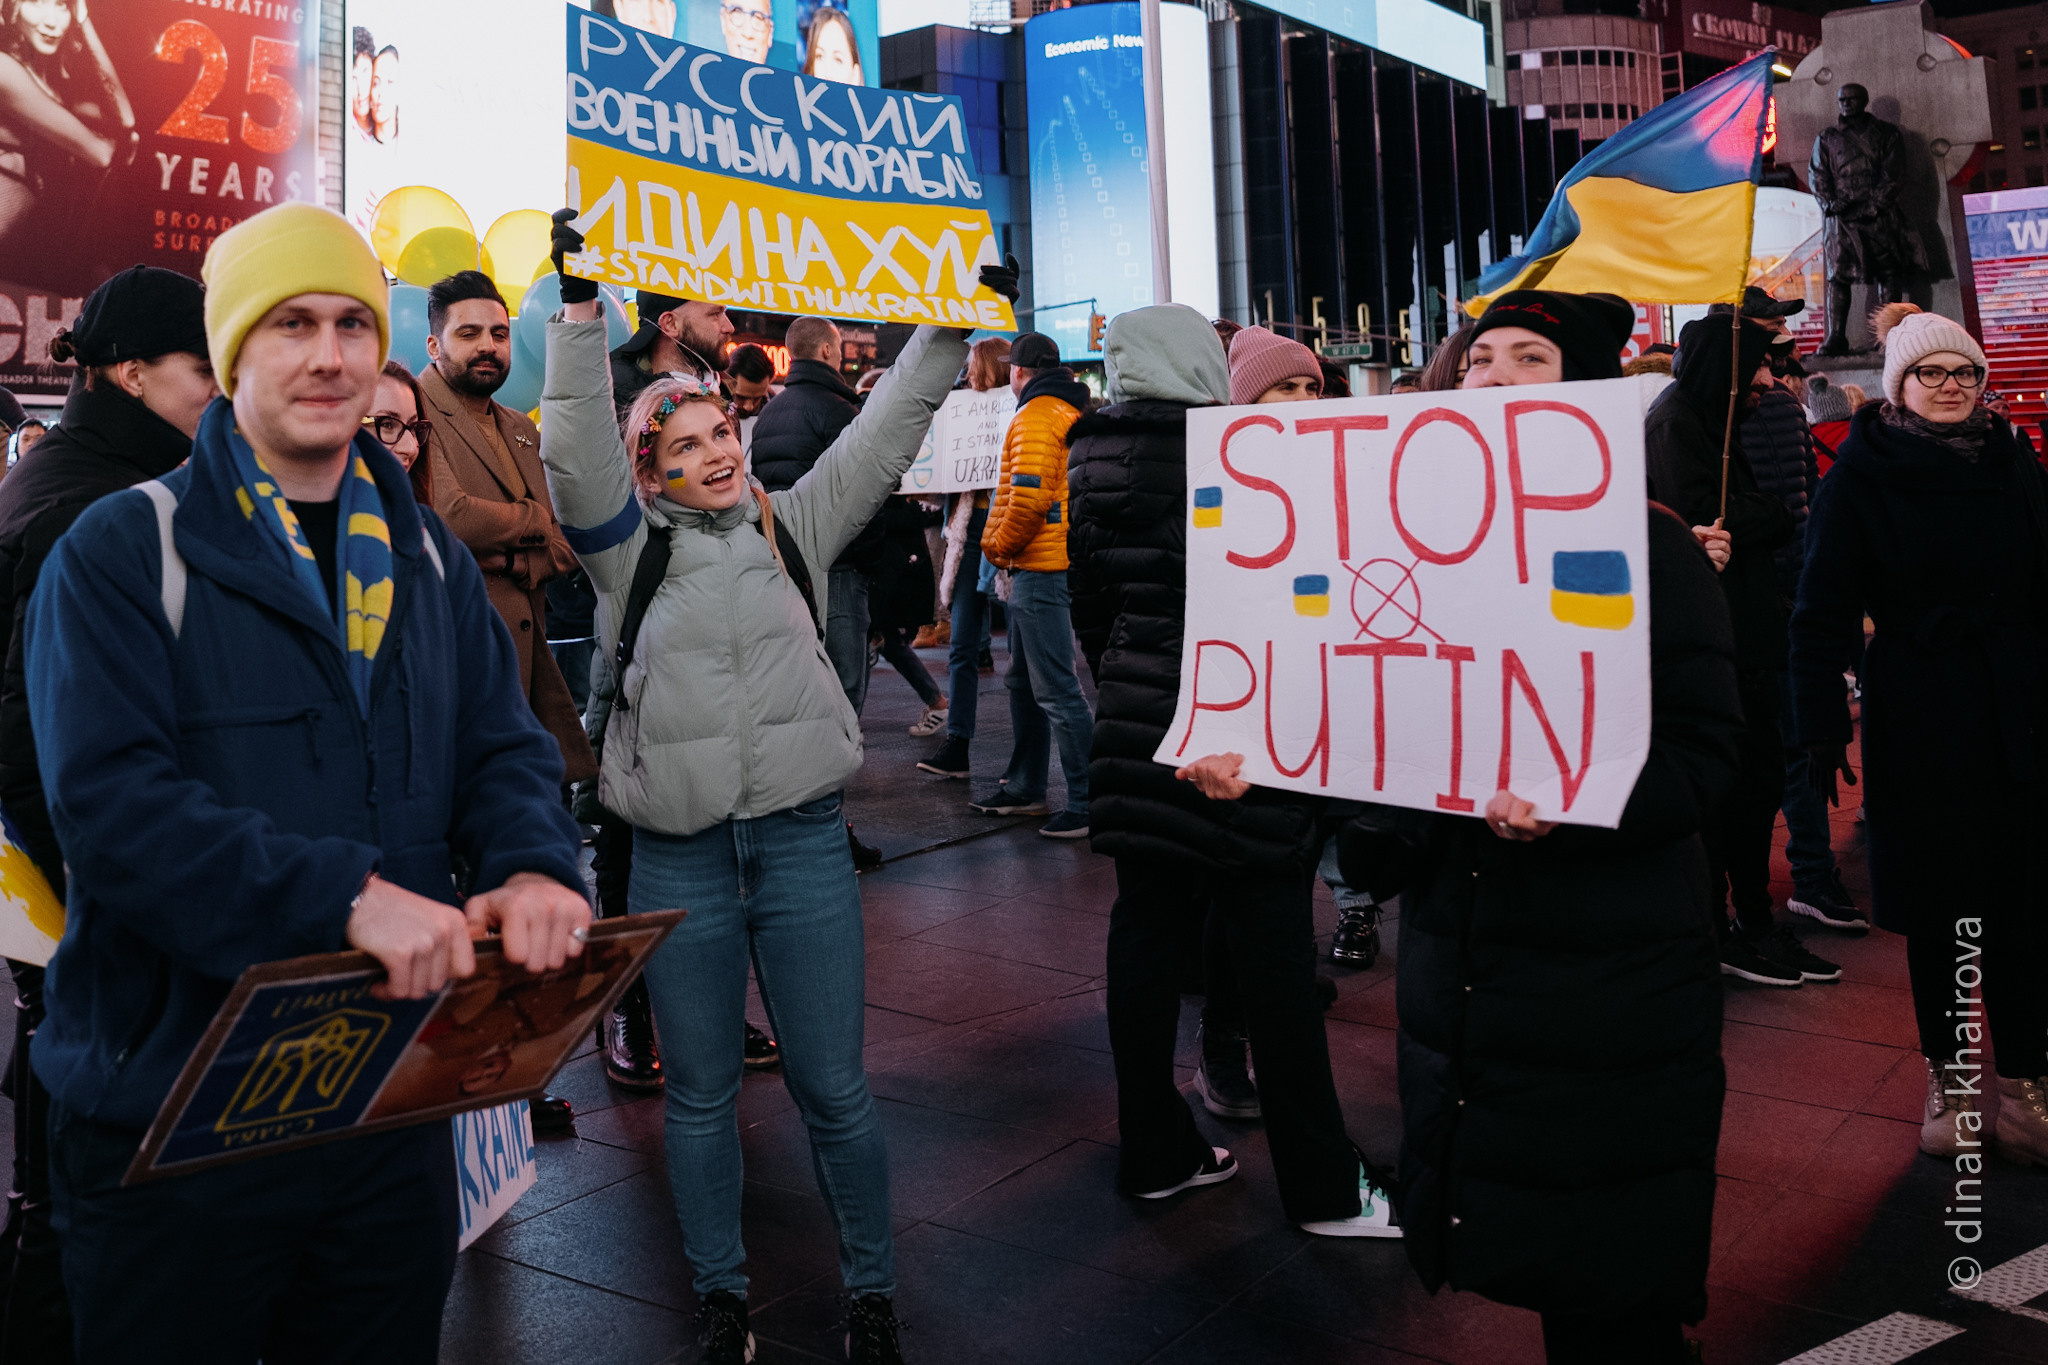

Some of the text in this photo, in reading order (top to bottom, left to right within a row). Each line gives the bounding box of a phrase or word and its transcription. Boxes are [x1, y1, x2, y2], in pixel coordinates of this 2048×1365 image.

[1044, 35, 1109, 58] Economic
[1692, 12, 1767, 46] CROWNE
[155, 18, 304, 154] 25
[580, 15, 966, 154] РУССКИЙ
[567, 72, 983, 200] ВОЕННЫЙ КОРАБЛЬ
[155, 152, 303, 204] YEARS
[155, 210, 246, 232] BROAD
[846, 220, 1008, 303] ХУЙ
[565, 244, 1006, 327] #STANDWITHUKRAINE
[951, 404, 962, 419] I
[968, 401, 988, 417] AM
[952, 432, 1003, 451] I STAND
[978, 421, 998, 431] AND
[1220, 400, 1612, 584] STOP
[1176, 639, 1594, 813] PUTIN
[450, 1099, 535, 1236] KRAINE
